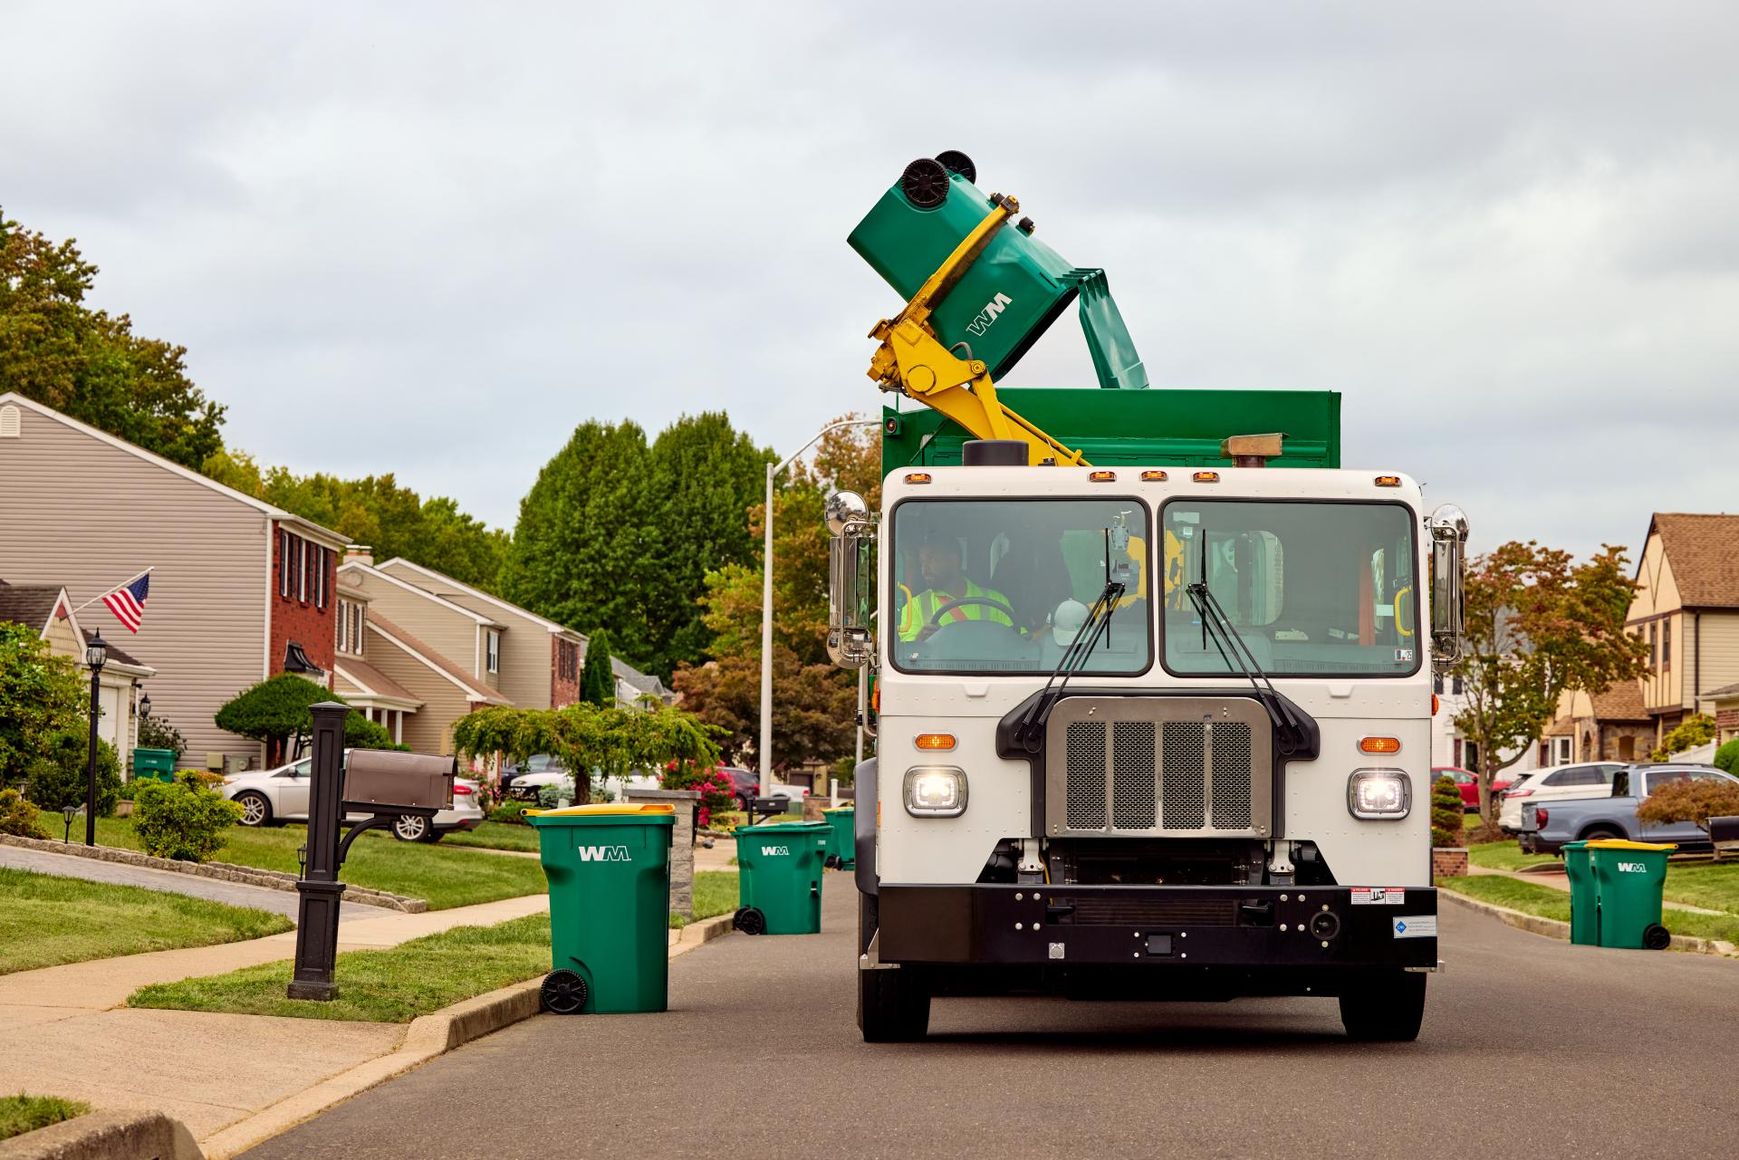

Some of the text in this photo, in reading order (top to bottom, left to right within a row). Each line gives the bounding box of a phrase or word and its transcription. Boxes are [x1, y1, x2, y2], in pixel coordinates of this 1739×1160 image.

[966, 292, 1012, 336] WM
[578, 846, 631, 861] WM
[761, 846, 789, 856] WM
[1617, 862, 1646, 872] WM
